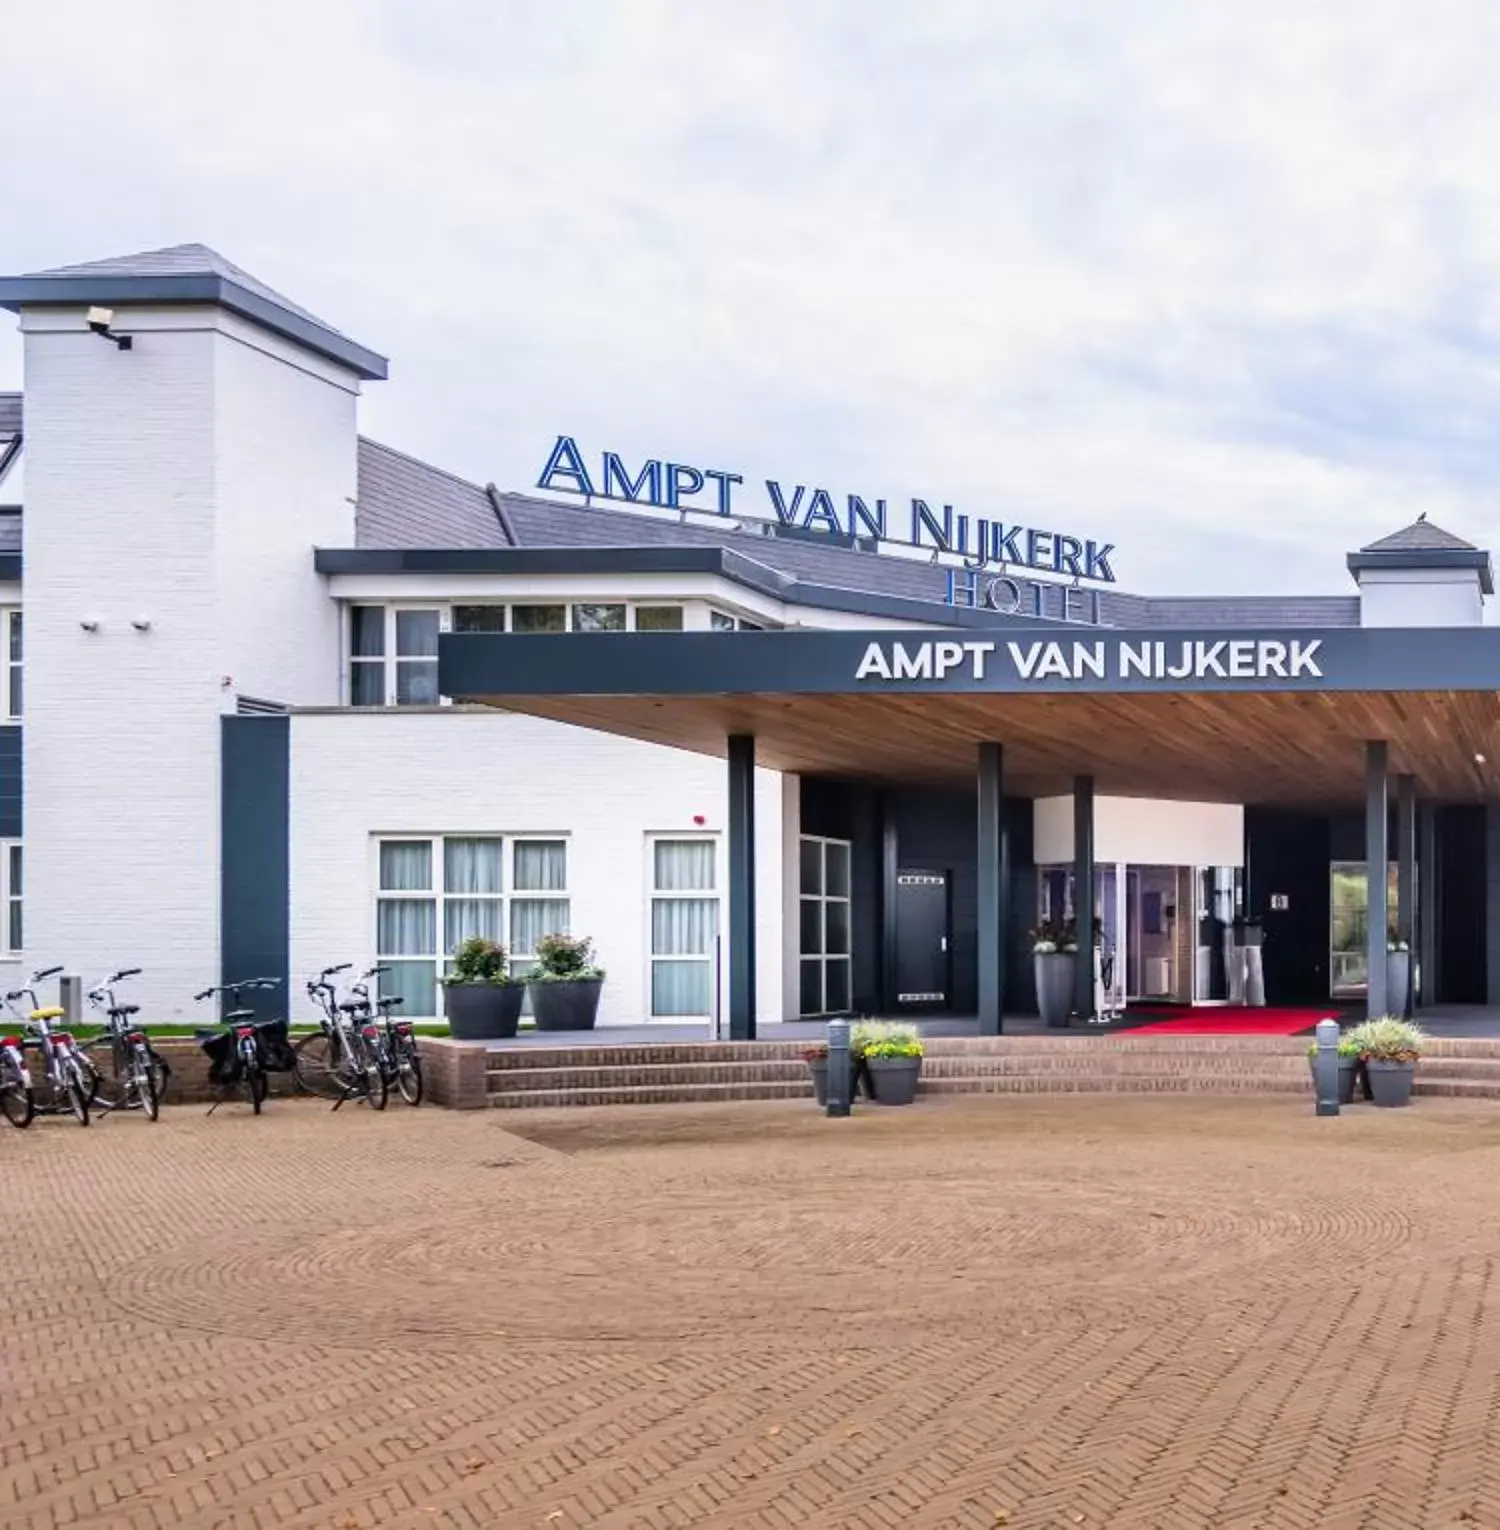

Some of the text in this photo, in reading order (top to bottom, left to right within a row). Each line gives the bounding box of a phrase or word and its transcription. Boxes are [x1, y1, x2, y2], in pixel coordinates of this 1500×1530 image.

[536, 435, 1116, 582] AMPT VAN NIJKERK
[855, 640, 1323, 679] AMPT VAN NIJKERK
